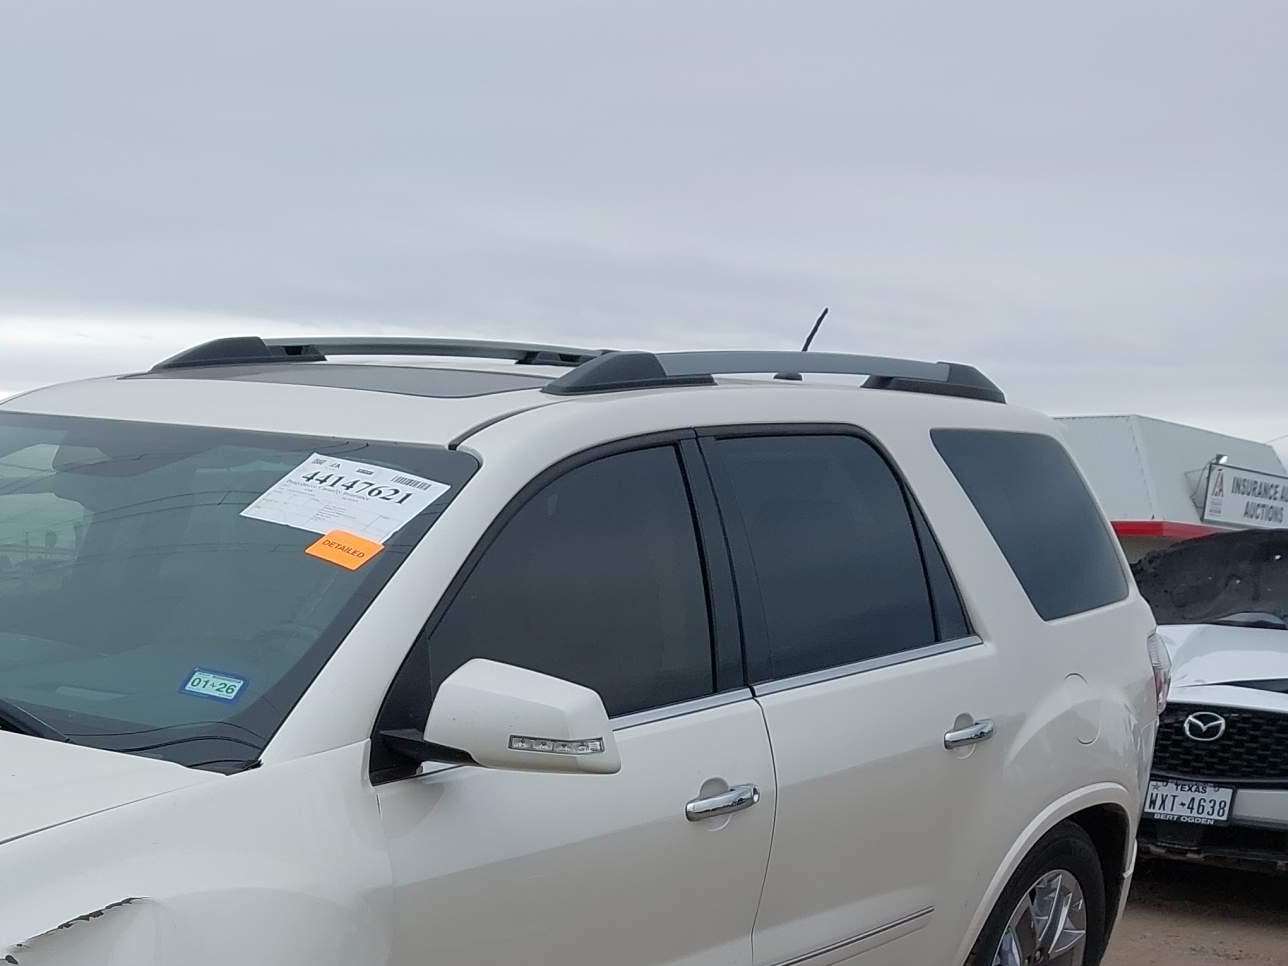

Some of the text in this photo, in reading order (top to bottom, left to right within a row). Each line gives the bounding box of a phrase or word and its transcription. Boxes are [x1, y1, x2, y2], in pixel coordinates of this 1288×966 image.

[302, 470, 413, 505] 44147621
[1232, 476, 1279, 501] INSURANCE
[1243, 501, 1283, 523] AUCTIONS
[321, 539, 365, 559] DETAILED
[1175, 783, 1208, 794] TEXAS
[1153, 813, 1215, 825] BERT OGDEN
